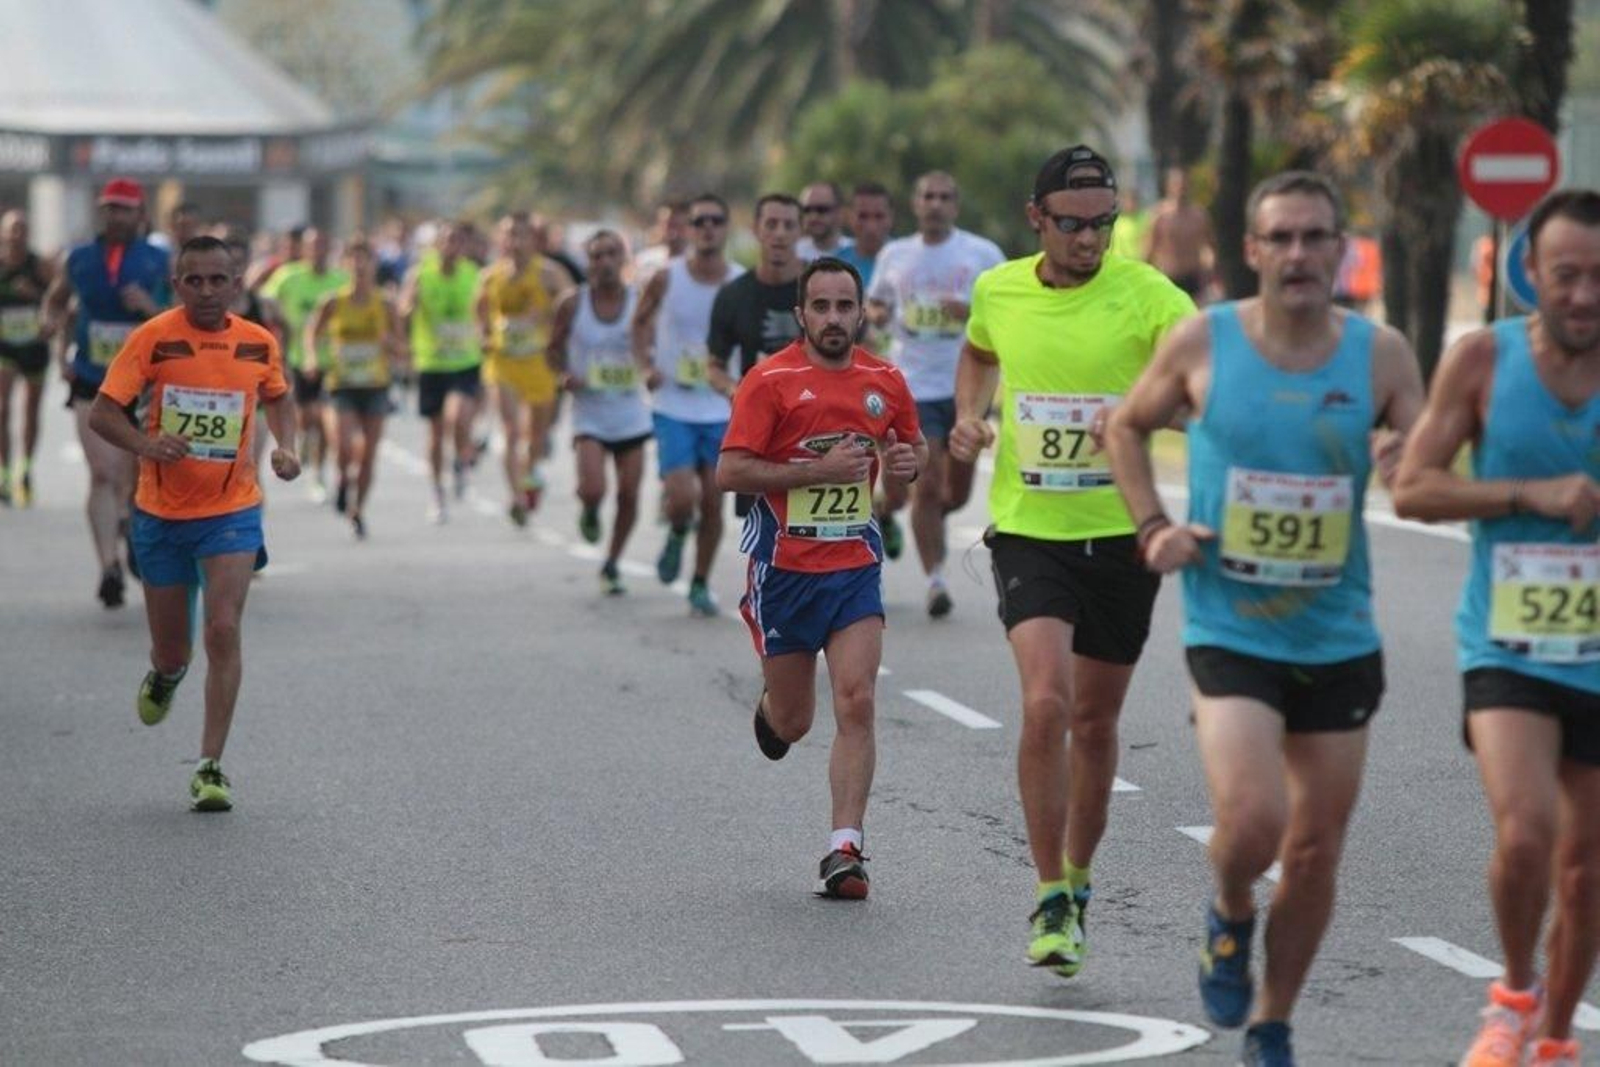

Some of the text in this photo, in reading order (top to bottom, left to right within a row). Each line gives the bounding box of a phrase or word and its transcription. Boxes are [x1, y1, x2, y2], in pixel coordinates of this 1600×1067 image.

[177, 413, 226, 439] 758
[1042, 428, 1086, 460] 87
[808, 486, 859, 514] 722
[1249, 511, 1325, 550] 591
[1520, 586, 1598, 624] 524
